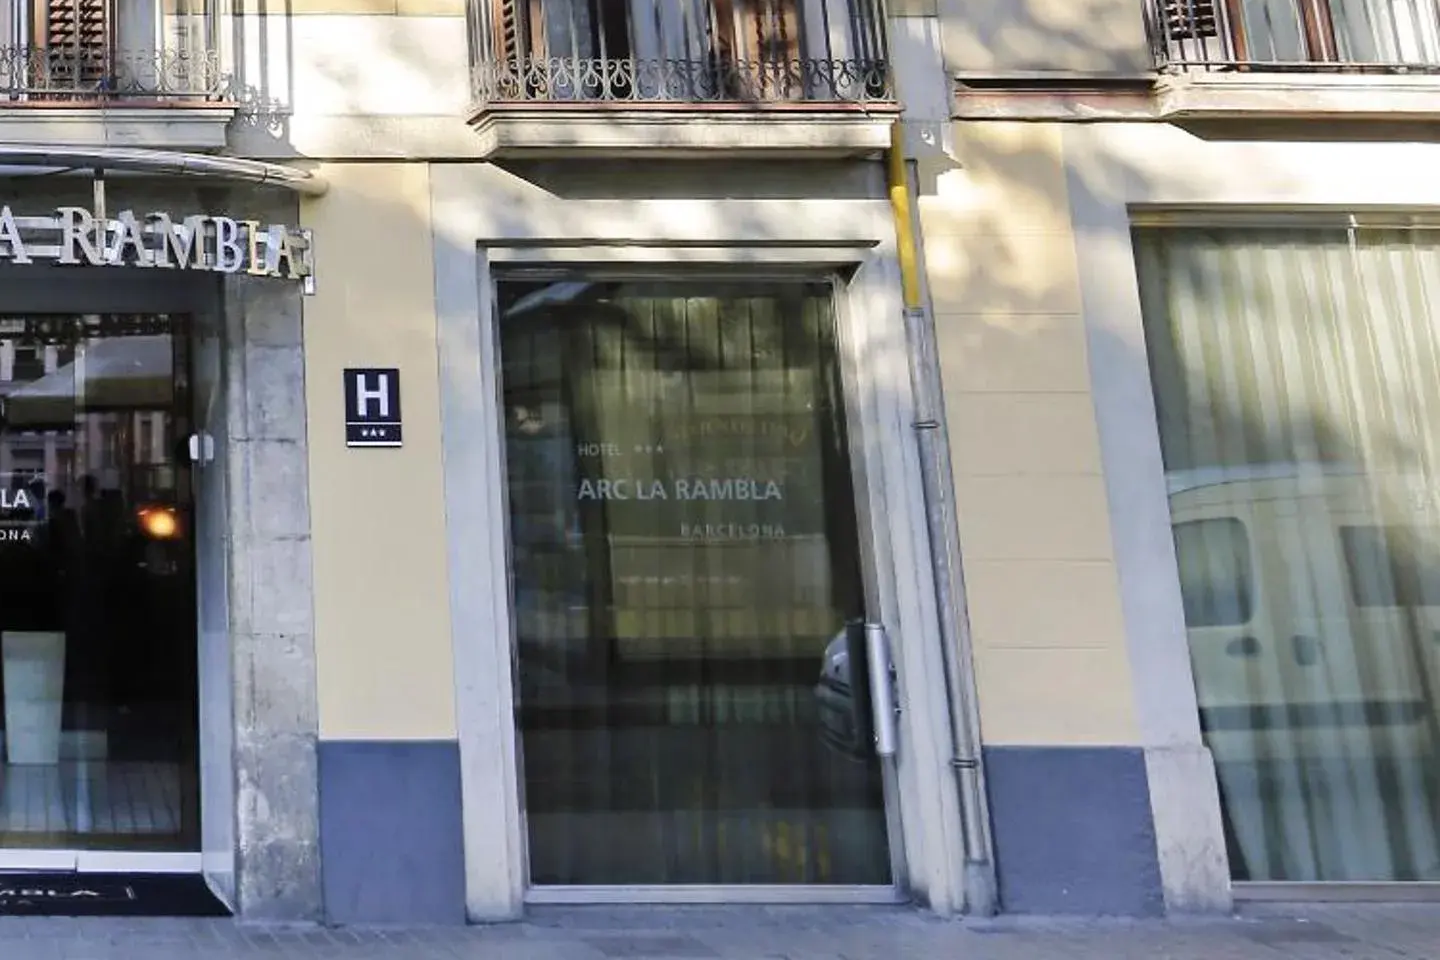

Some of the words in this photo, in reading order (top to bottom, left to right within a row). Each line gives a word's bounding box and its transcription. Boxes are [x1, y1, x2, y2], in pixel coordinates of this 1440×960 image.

[56, 205, 301, 279] RAMBLA
[356, 373, 389, 416] H
[578, 443, 623, 456] HOTEL
[578, 479, 630, 500] ARC
[636, 479, 667, 500] LA
[675, 479, 783, 500] RAMBLA
[680, 523, 786, 539] BARCELONA
